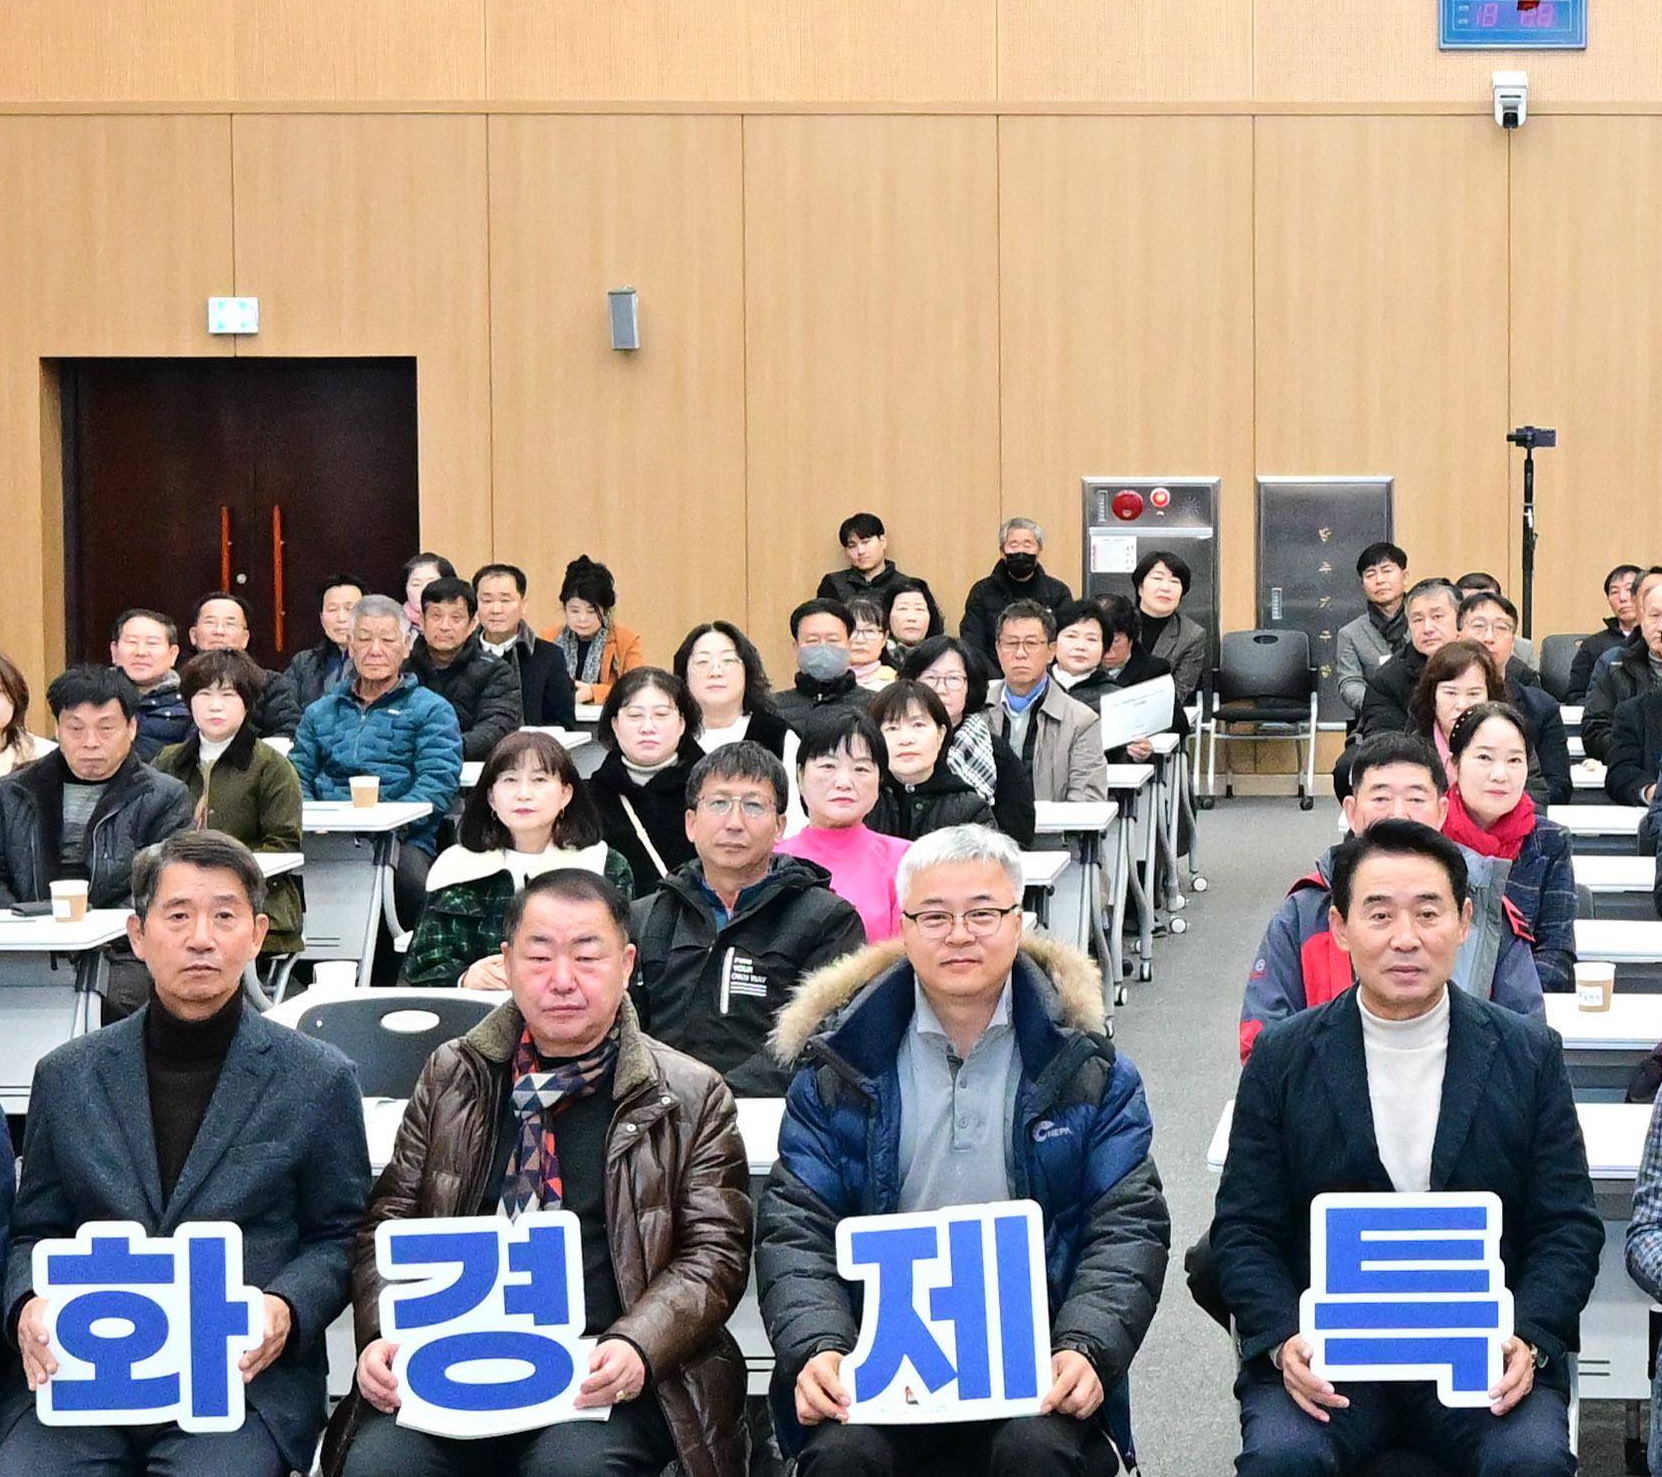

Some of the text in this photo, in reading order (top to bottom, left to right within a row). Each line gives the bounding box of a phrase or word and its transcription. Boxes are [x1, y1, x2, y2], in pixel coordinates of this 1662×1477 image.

[46, 1236, 250, 1419] 화
[390, 1224, 576, 1413] 경
[850, 1214, 1040, 1404] 제
[1314, 1206, 1500, 1393] 특
